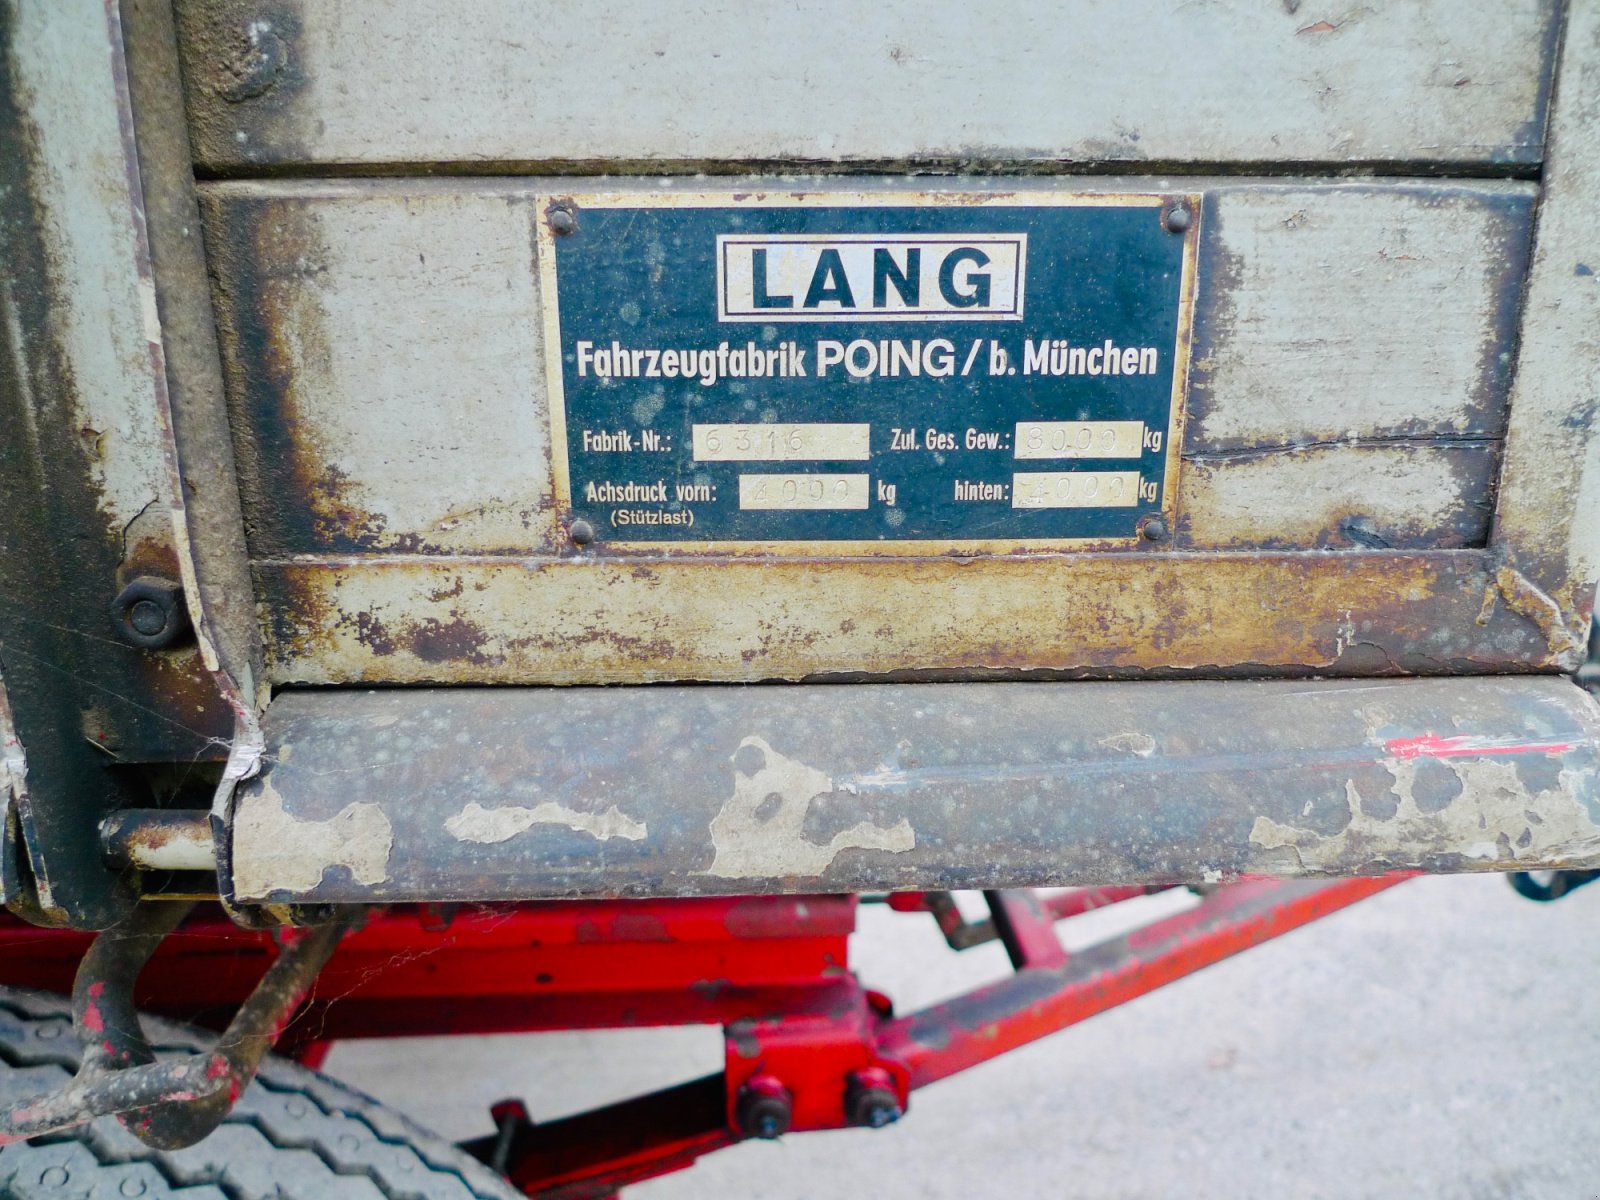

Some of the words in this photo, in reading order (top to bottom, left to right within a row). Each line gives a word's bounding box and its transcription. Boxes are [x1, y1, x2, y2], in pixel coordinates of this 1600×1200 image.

[752, 247, 991, 308] LANG
[577, 340, 807, 386] Fahrzeugfabrik
[817, 338, 955, 377] POING
[989, 339, 1016, 376] b.
[1023, 339, 1157, 376] München
[583, 430, 671, 452] Fabrik-Nr.:
[891, 428, 919, 450] Zul.
[925, 428, 959, 450] Ges.
[965, 428, 1010, 450] Gew.:
[1143, 427, 1162, 452] kg
[587, 481, 667, 503] Achsdruck
[676, 482, 716, 502] vorn:
[877, 480, 896, 505] kg
[955, 480, 1009, 501] hinten:
[1139, 479, 1158, 504] kg
[610, 509, 694, 526] (Stützlast)
